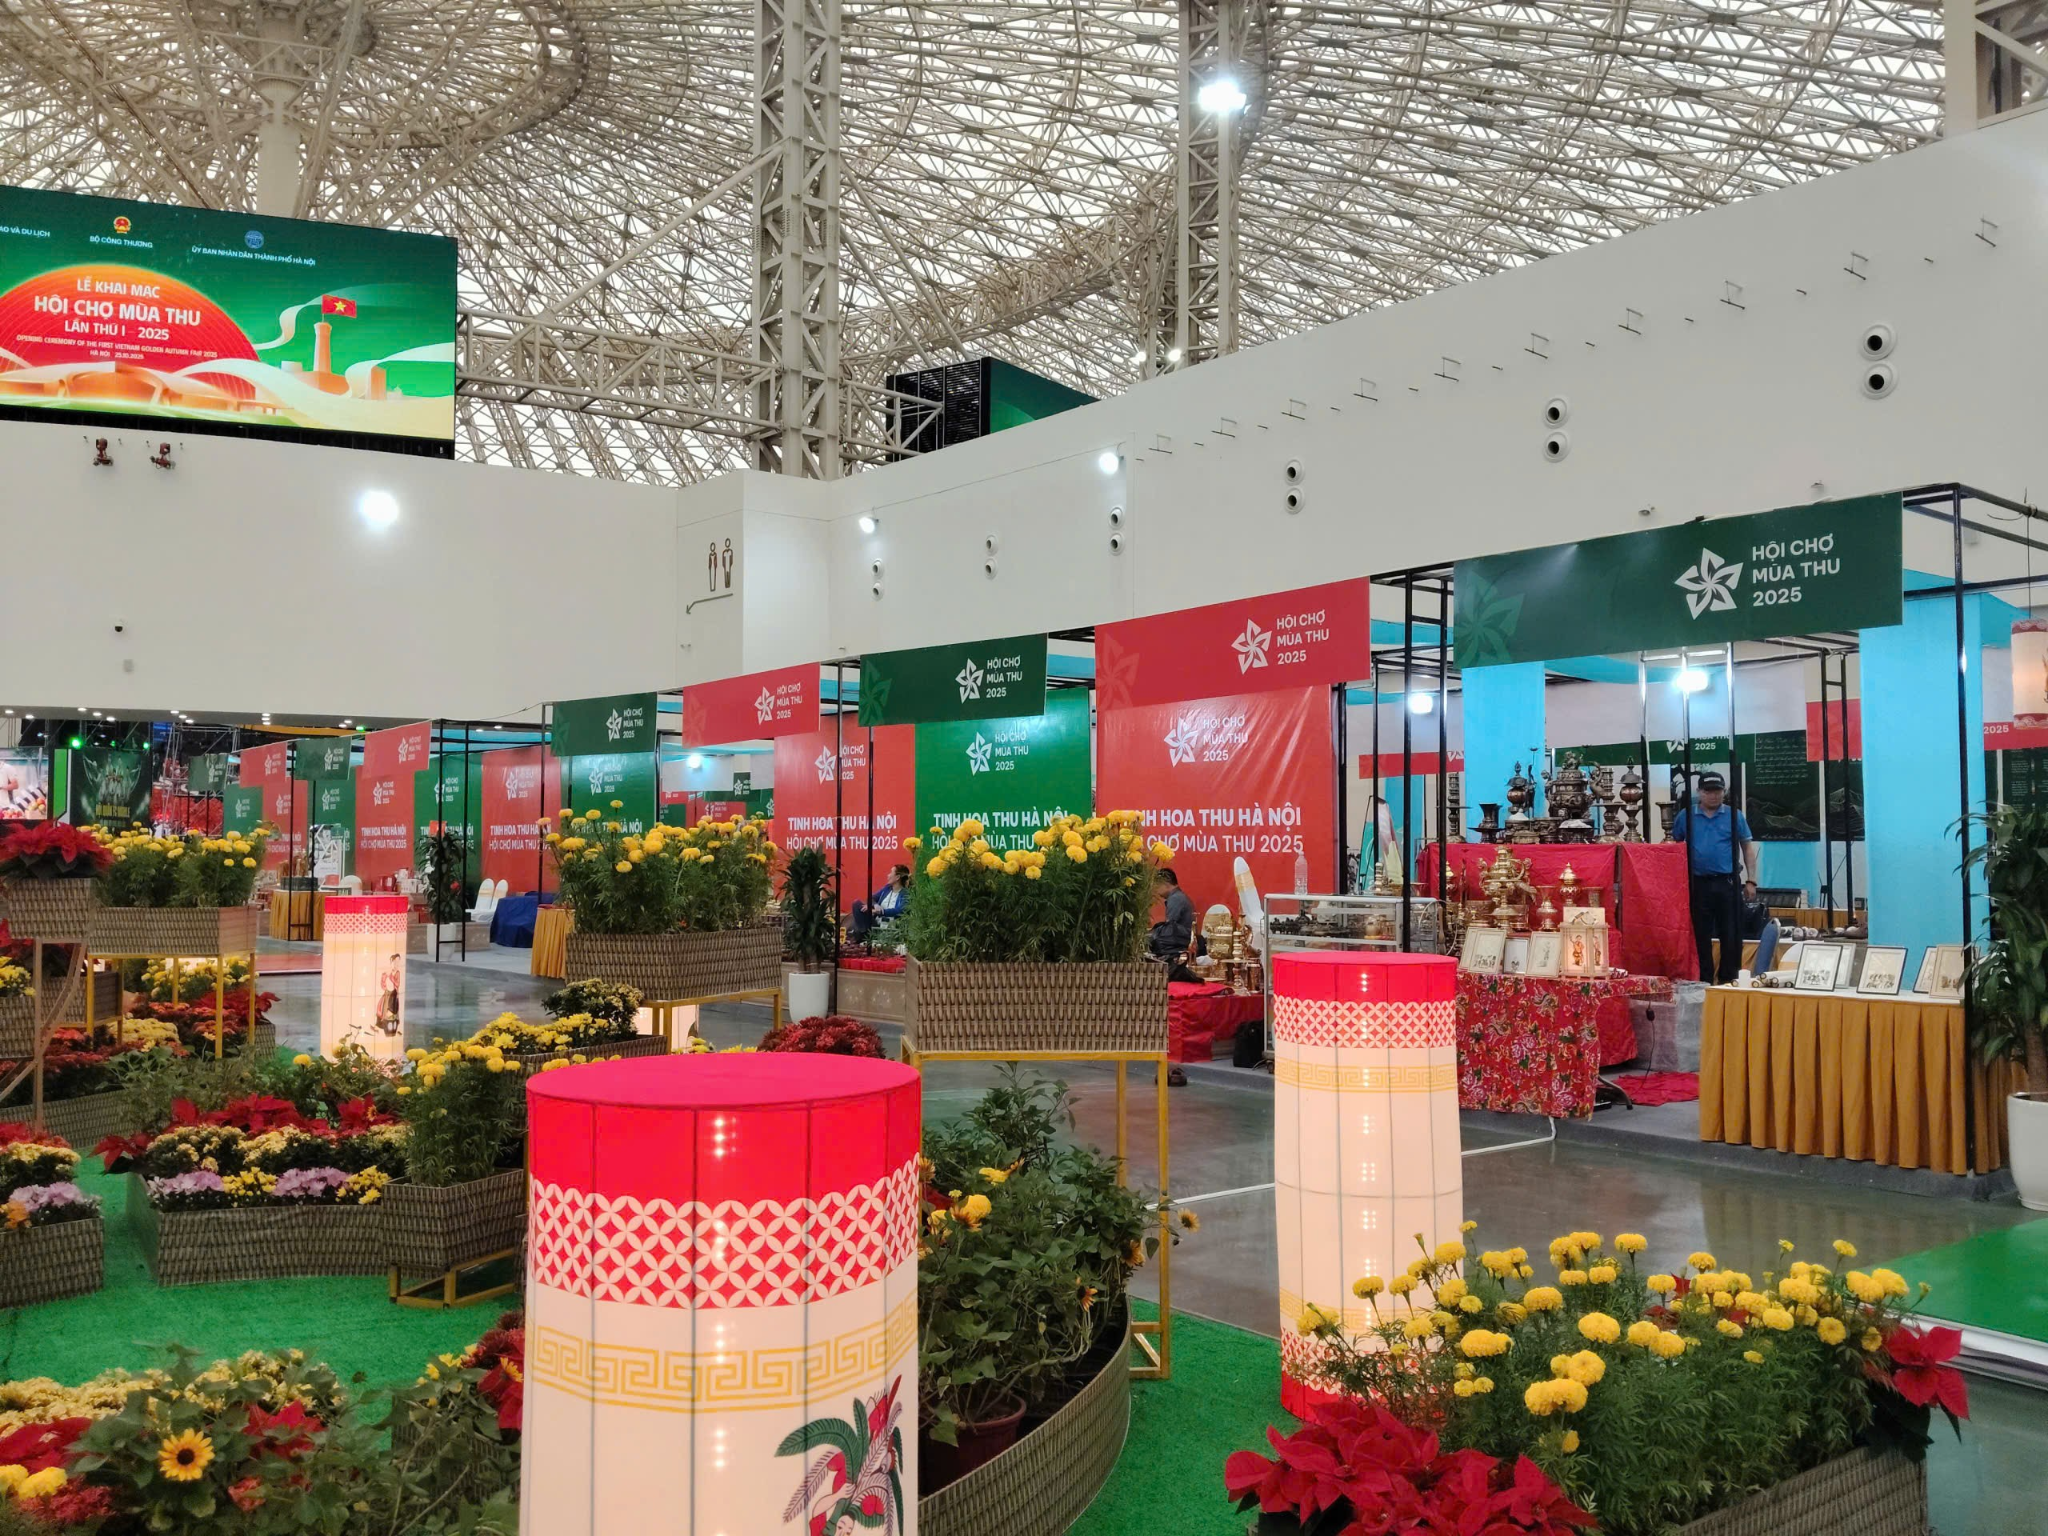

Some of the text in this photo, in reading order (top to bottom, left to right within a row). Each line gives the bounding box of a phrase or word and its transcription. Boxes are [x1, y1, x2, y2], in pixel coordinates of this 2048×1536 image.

[21, 228, 32, 236] DU
[202, 247, 217, 256] BAN
[77, 275, 160, 299] LỄ KHAI MẠC
[34, 294, 201, 327] HỘI CHỢ MÙA THU
[137, 326, 170, 341] 2025
[76, 339, 85, 347] OF
[86, 340, 98, 348] THE
[98, 341, 114, 349] FIRST
[114, 342, 141, 351] VIETNAM
[141, 345, 164, 353] GOLDEN
[164, 347, 189, 356] AUTUMN
[1752, 533, 1834, 562] HỘI CHỢ
[1799, 557, 1841, 578] THU
[1752, 586, 1803, 607] 2025
[1276, 609, 1326, 631] HỘI CHỢ
[1276, 628, 1330, 648] MÙA THU
[987, 655, 1021, 670] HỘI CHỢ
[1277, 649, 1307, 665] 2025
[986, 671, 1023, 684] MÙA THU
[776, 682, 801, 696] HỘI CHỢ
[986, 687, 1007, 699] 2025
[776, 695, 802, 707] MÙA THU
[776, 709, 791, 719] 2025
[634, 718, 644, 727] THU
[622, 730, 635, 739] 2025
[1984, 725, 2009, 734] 2025
[1227, 731, 1249, 744] THU
[850, 744, 865, 755] CHỢ
[1013, 745, 1029, 756] THU
[1203, 750, 1229, 762] 2025
[853, 758, 866, 767] THU
[995, 760, 1015, 771] 2025
[841, 771, 854, 780] 025
[787, 817, 810, 831] TINH
[812, 817, 834, 831] HOA
[841, 815, 857, 830] HU
[876, 811, 897, 834] NỘI
[933, 812, 961, 829] TINH
[992, 811, 1019, 827] THU
[1021, 806, 1041, 827] HÀ
[1160, 809, 1195, 827] HOA
[1199, 808, 1234, 827] THU
[1238, 802, 1264, 827] HÀ
[1268, 801, 1301, 832] NỘI
[504, 824, 517, 836] HOA
[517, 824, 530, 835] THU
[525, 839, 537, 850] THU
[786, 833, 802, 850] HỘI
[849, 836, 869, 850] THU
[872, 836, 898, 850] 2025
[1009, 834, 1035, 850] THU
[1183, 830, 1219, 852] MÙA
[1222, 835, 1255, 852] THU
[1260, 835, 1304, 853] 2025
